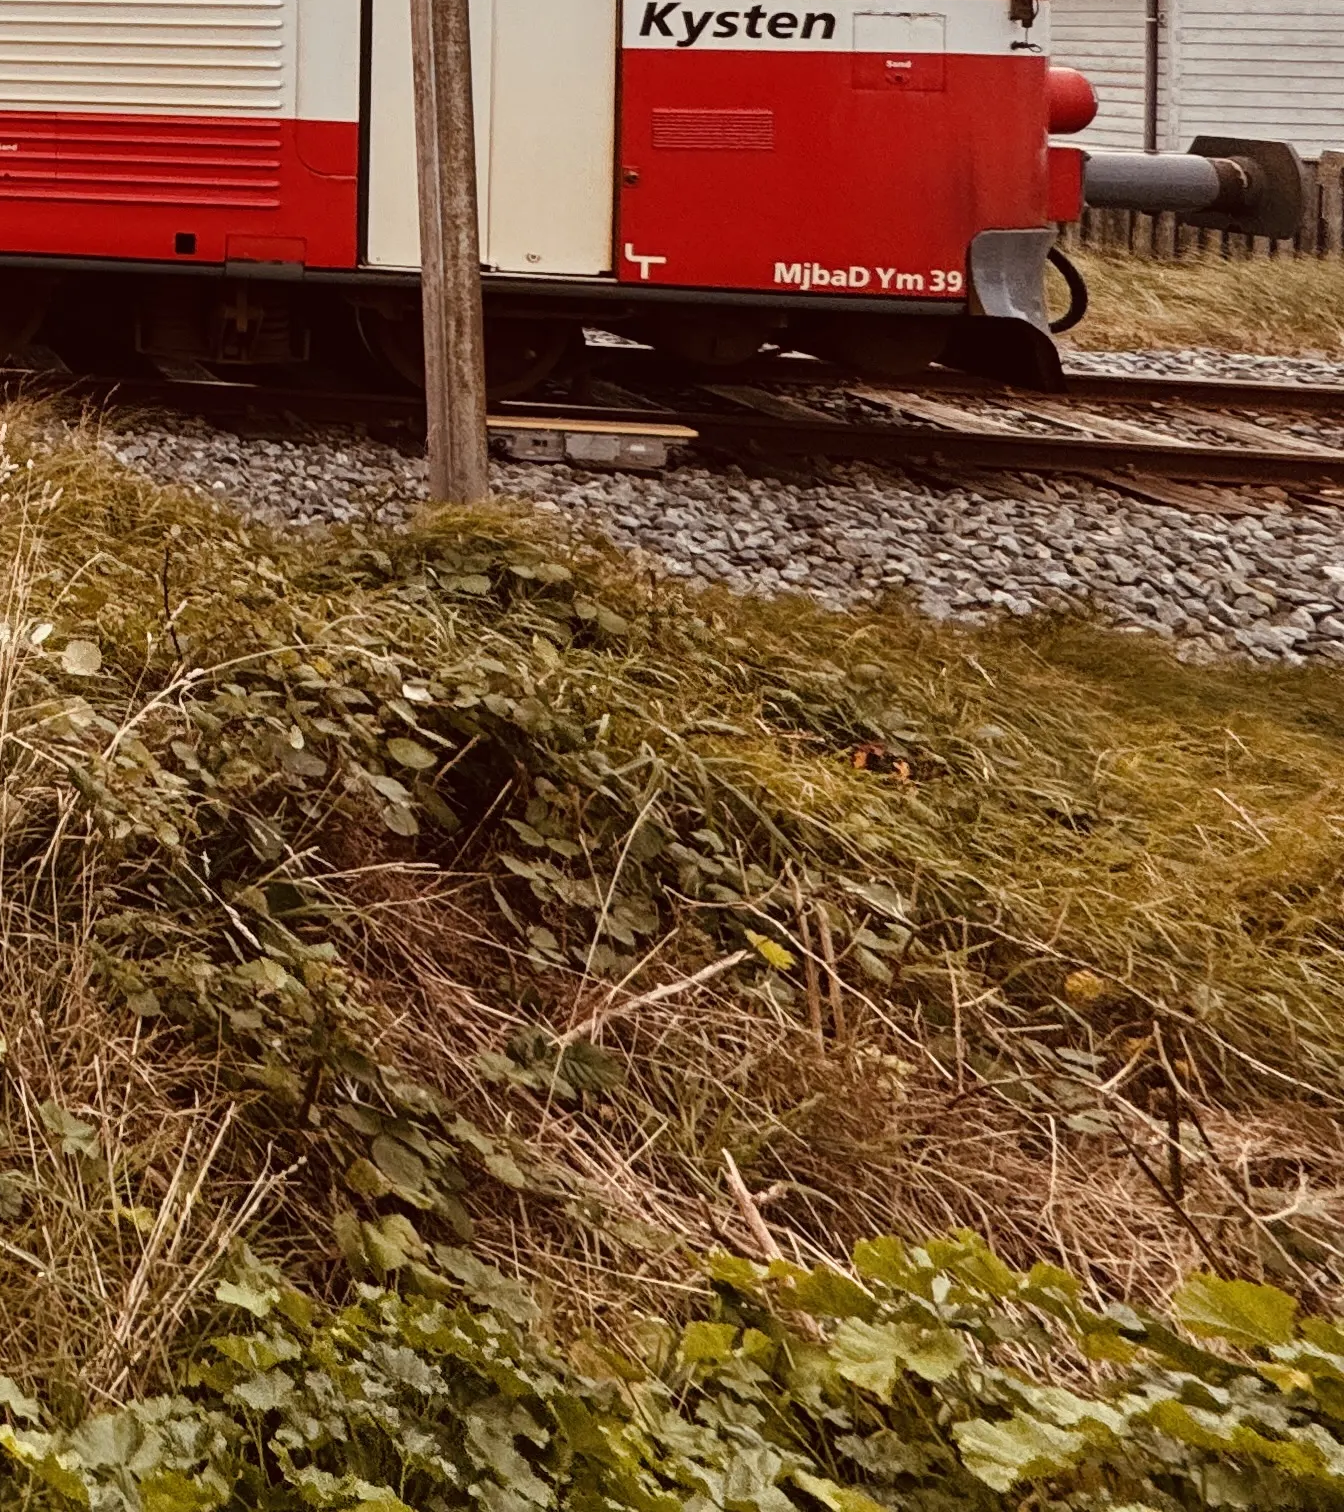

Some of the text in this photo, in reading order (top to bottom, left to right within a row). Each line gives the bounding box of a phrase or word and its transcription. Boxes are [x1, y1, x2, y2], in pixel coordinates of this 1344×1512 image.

[639, 1, 837, 48] Kysten
[773, 261, 963, 292] MjbaD Ym 39
